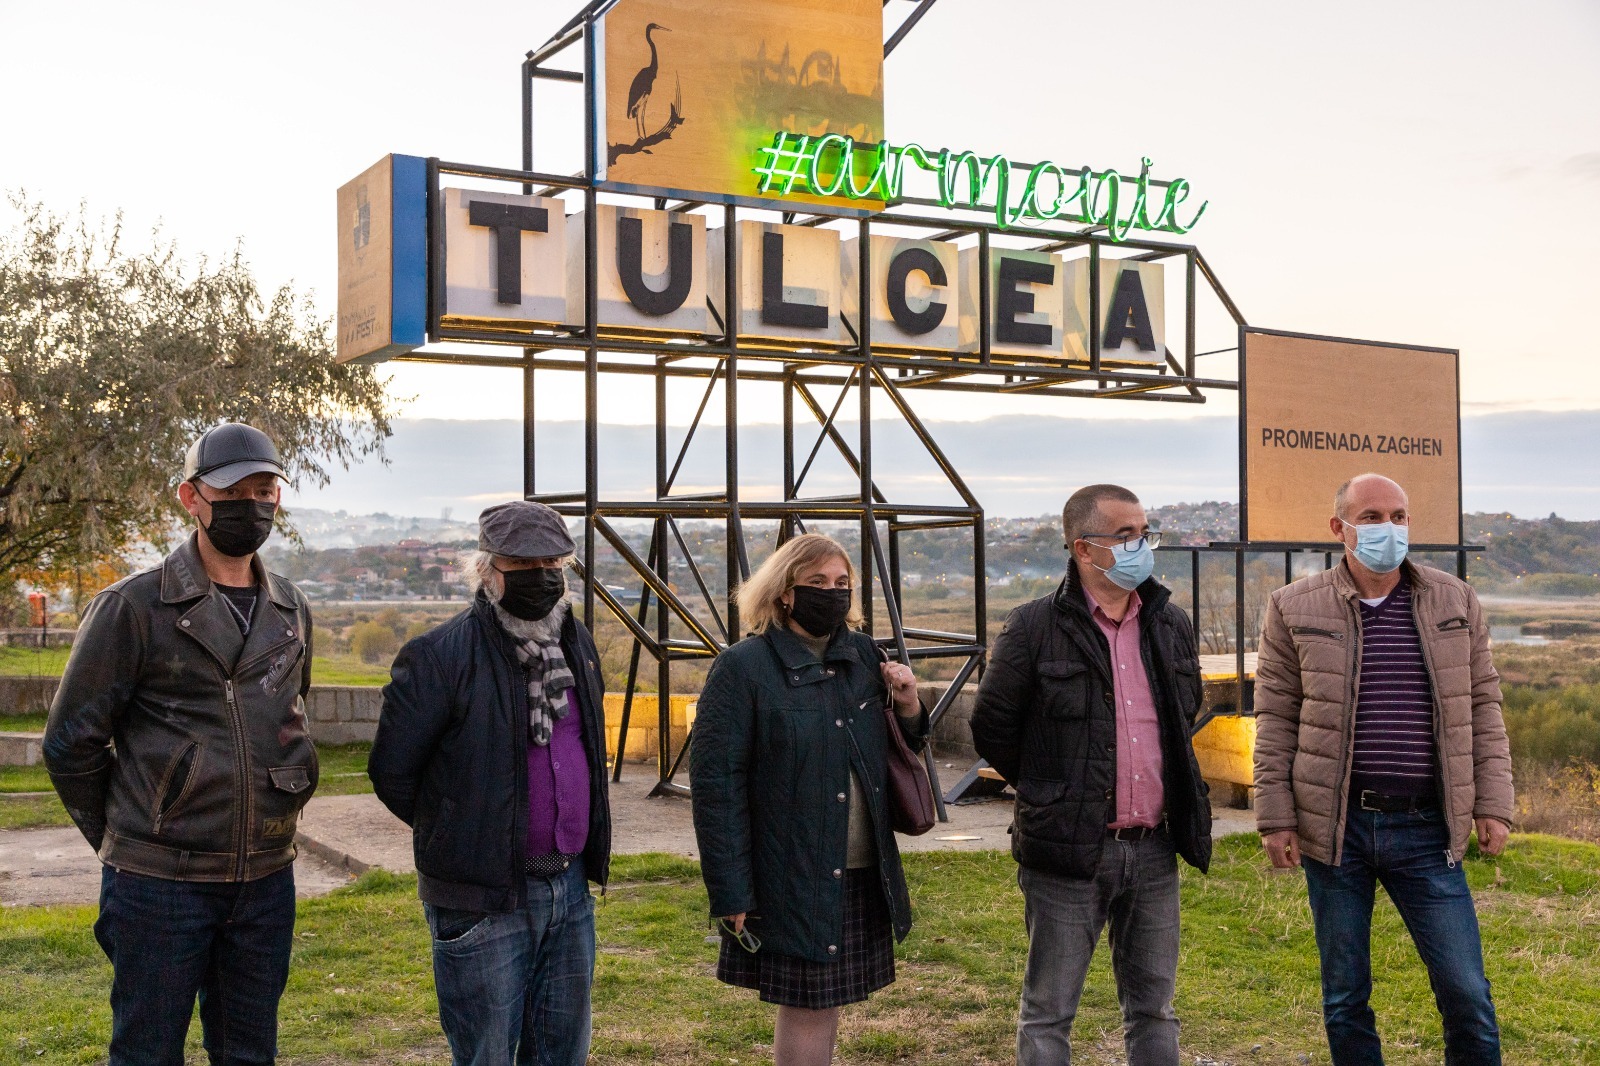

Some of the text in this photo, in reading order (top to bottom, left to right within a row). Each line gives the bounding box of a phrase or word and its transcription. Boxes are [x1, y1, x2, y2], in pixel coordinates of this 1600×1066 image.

[469, 200, 1156, 352] TULCEA
[1262, 428, 1442, 456] PROMENADA ZAGHEN
